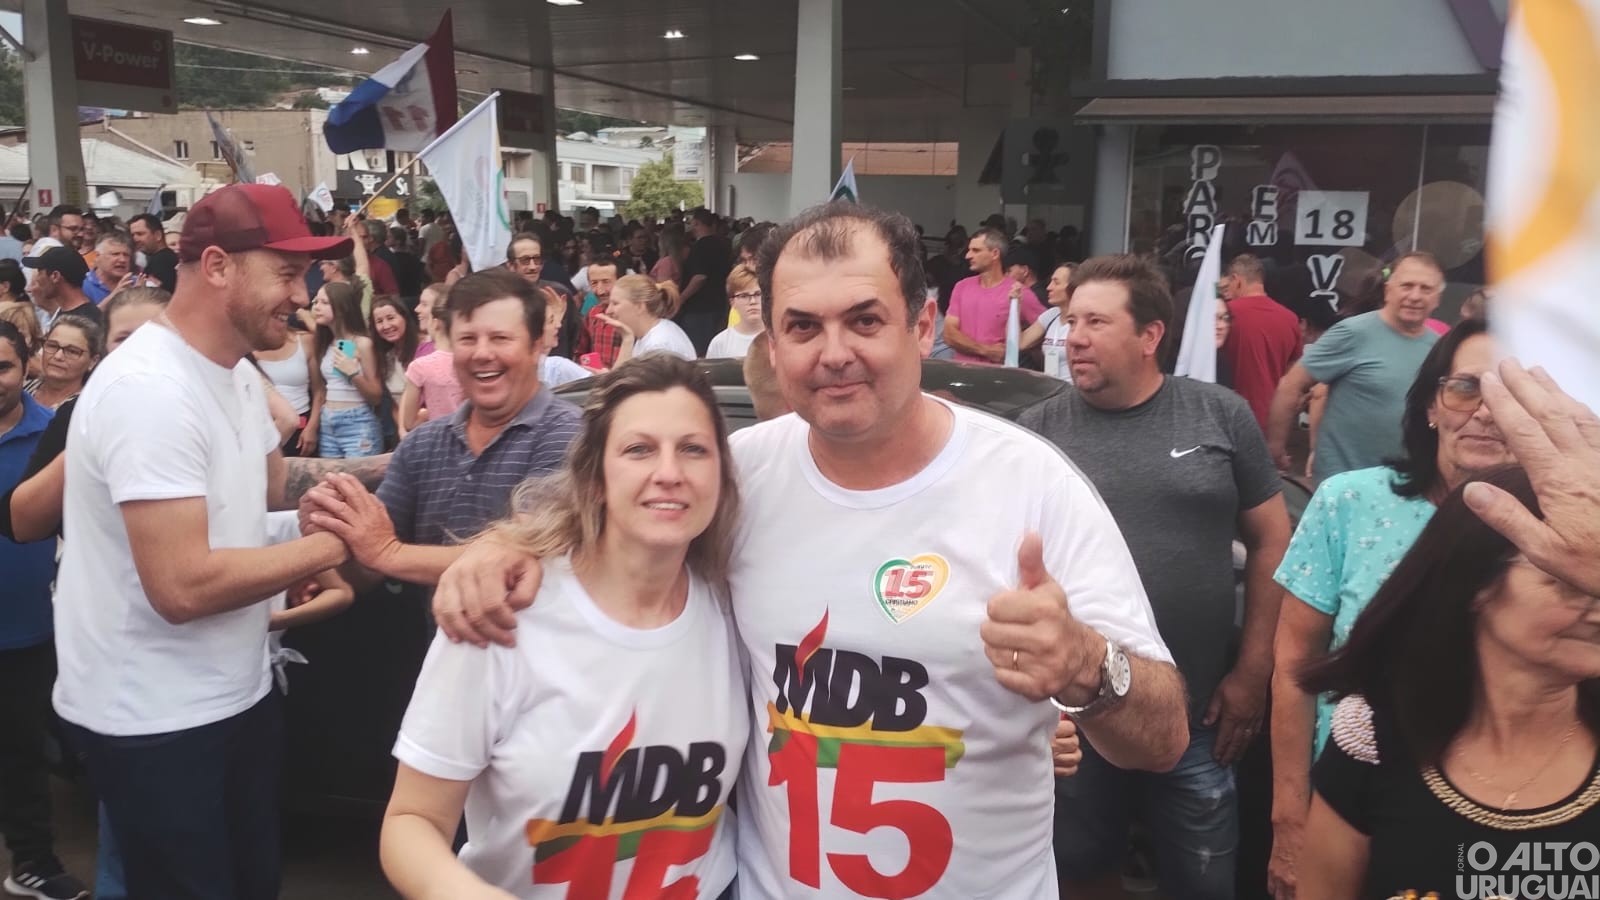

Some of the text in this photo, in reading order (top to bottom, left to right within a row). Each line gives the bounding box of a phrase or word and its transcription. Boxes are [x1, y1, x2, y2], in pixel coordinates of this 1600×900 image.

[81, 41, 160, 70] V-Power
[1304, 209, 1355, 240] 18
[884, 568, 934, 599] 15
[773, 643, 929, 732] MDB
[558, 741, 726, 826] MDB
[767, 730, 954, 900] 15
